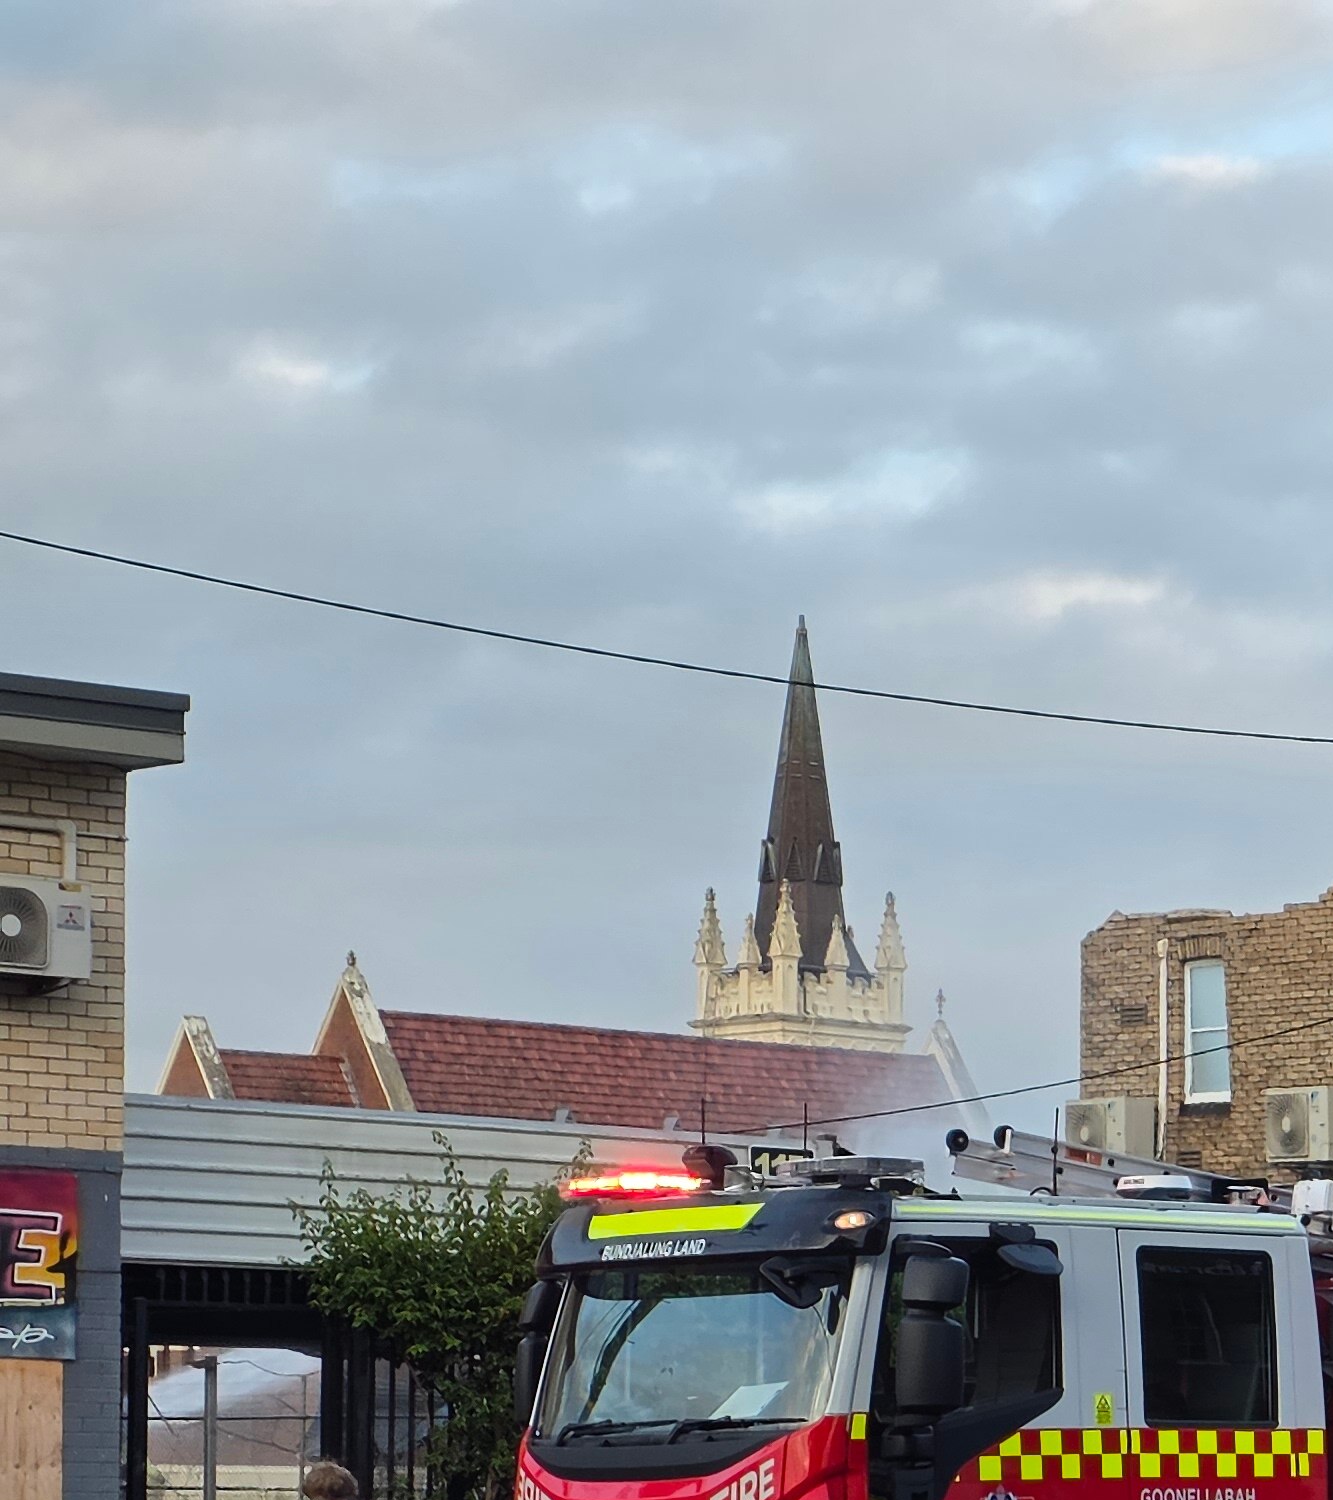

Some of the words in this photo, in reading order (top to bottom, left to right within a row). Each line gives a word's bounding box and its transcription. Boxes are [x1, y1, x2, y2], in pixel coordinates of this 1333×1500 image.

[754, 1152, 804, 1178] 11
[601, 1241, 673, 1261] BUNDJALUNG
[673, 1239, 706, 1255] LAND
